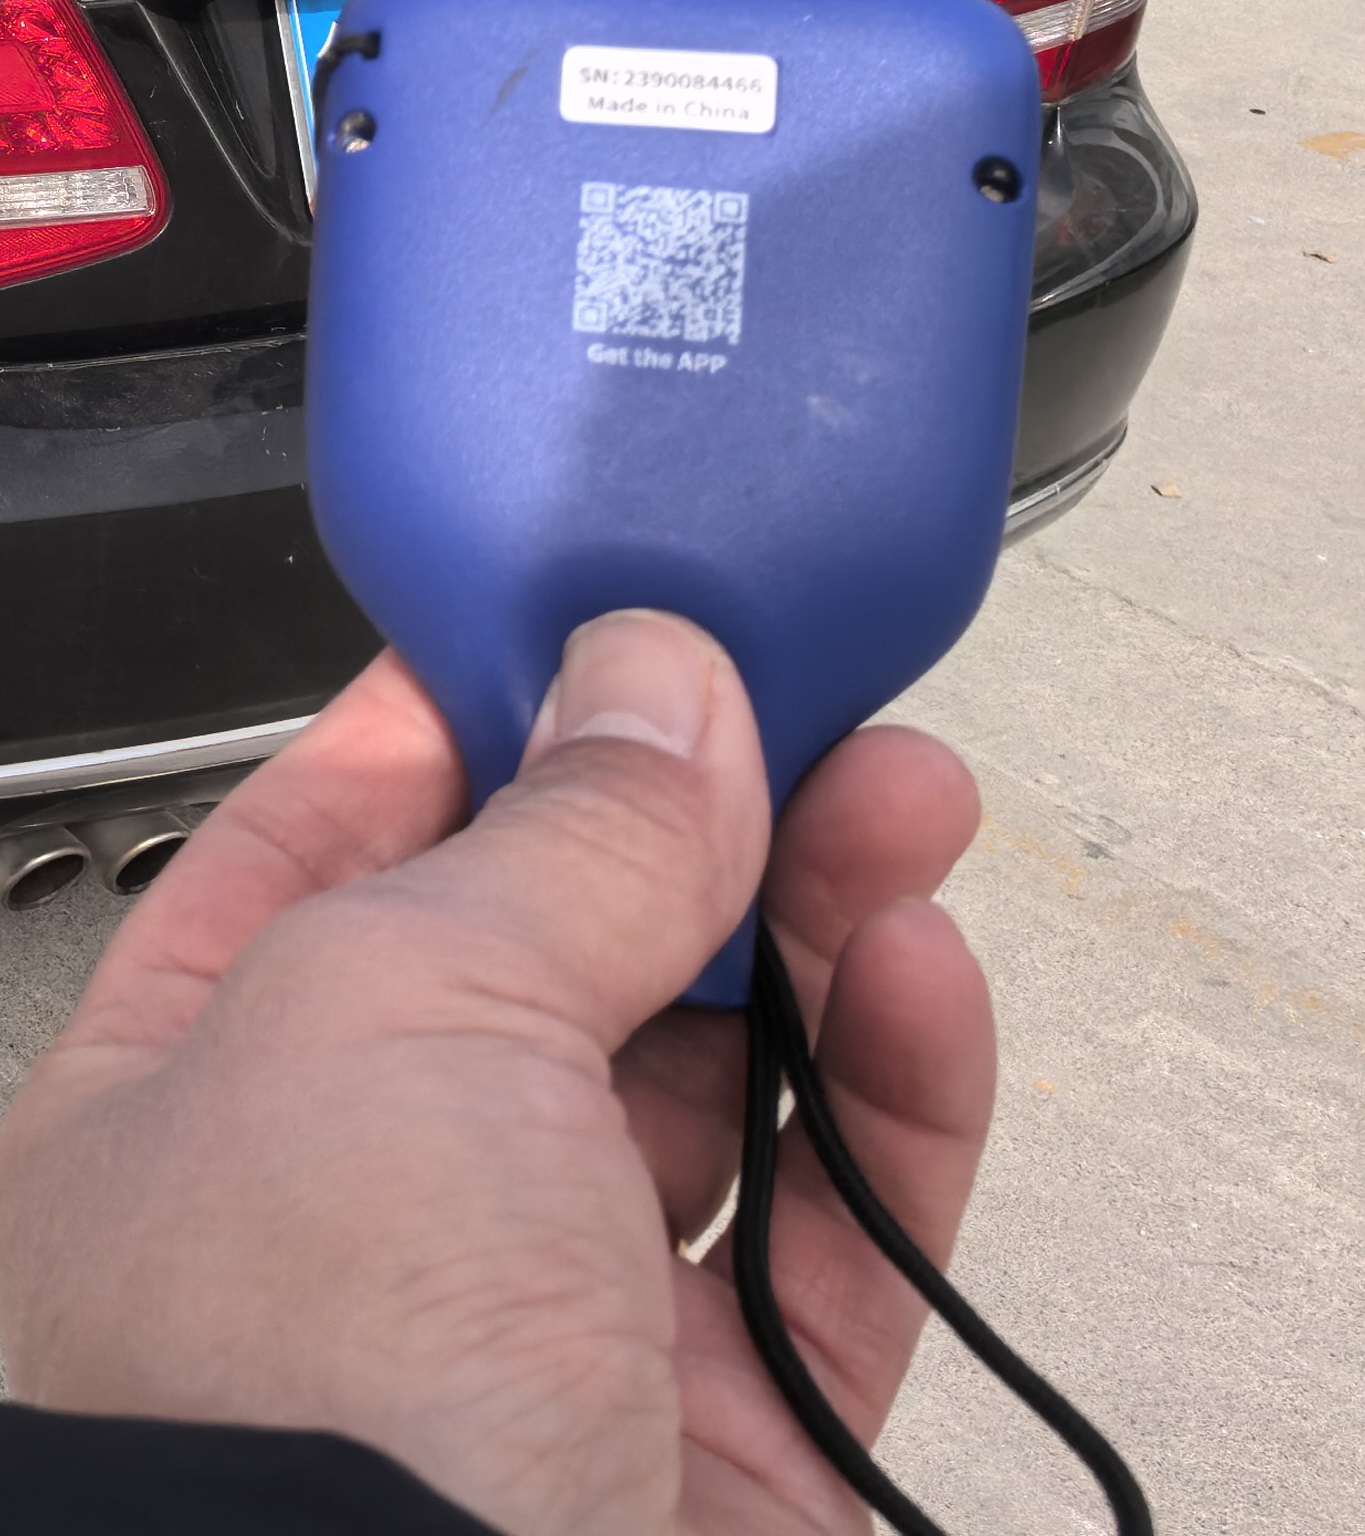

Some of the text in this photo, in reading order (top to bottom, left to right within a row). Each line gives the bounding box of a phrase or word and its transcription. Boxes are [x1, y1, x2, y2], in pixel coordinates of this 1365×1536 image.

[587, 95, 750, 121] Made in China
[586, 343, 629, 366] Get
[634, 347, 672, 369] the
